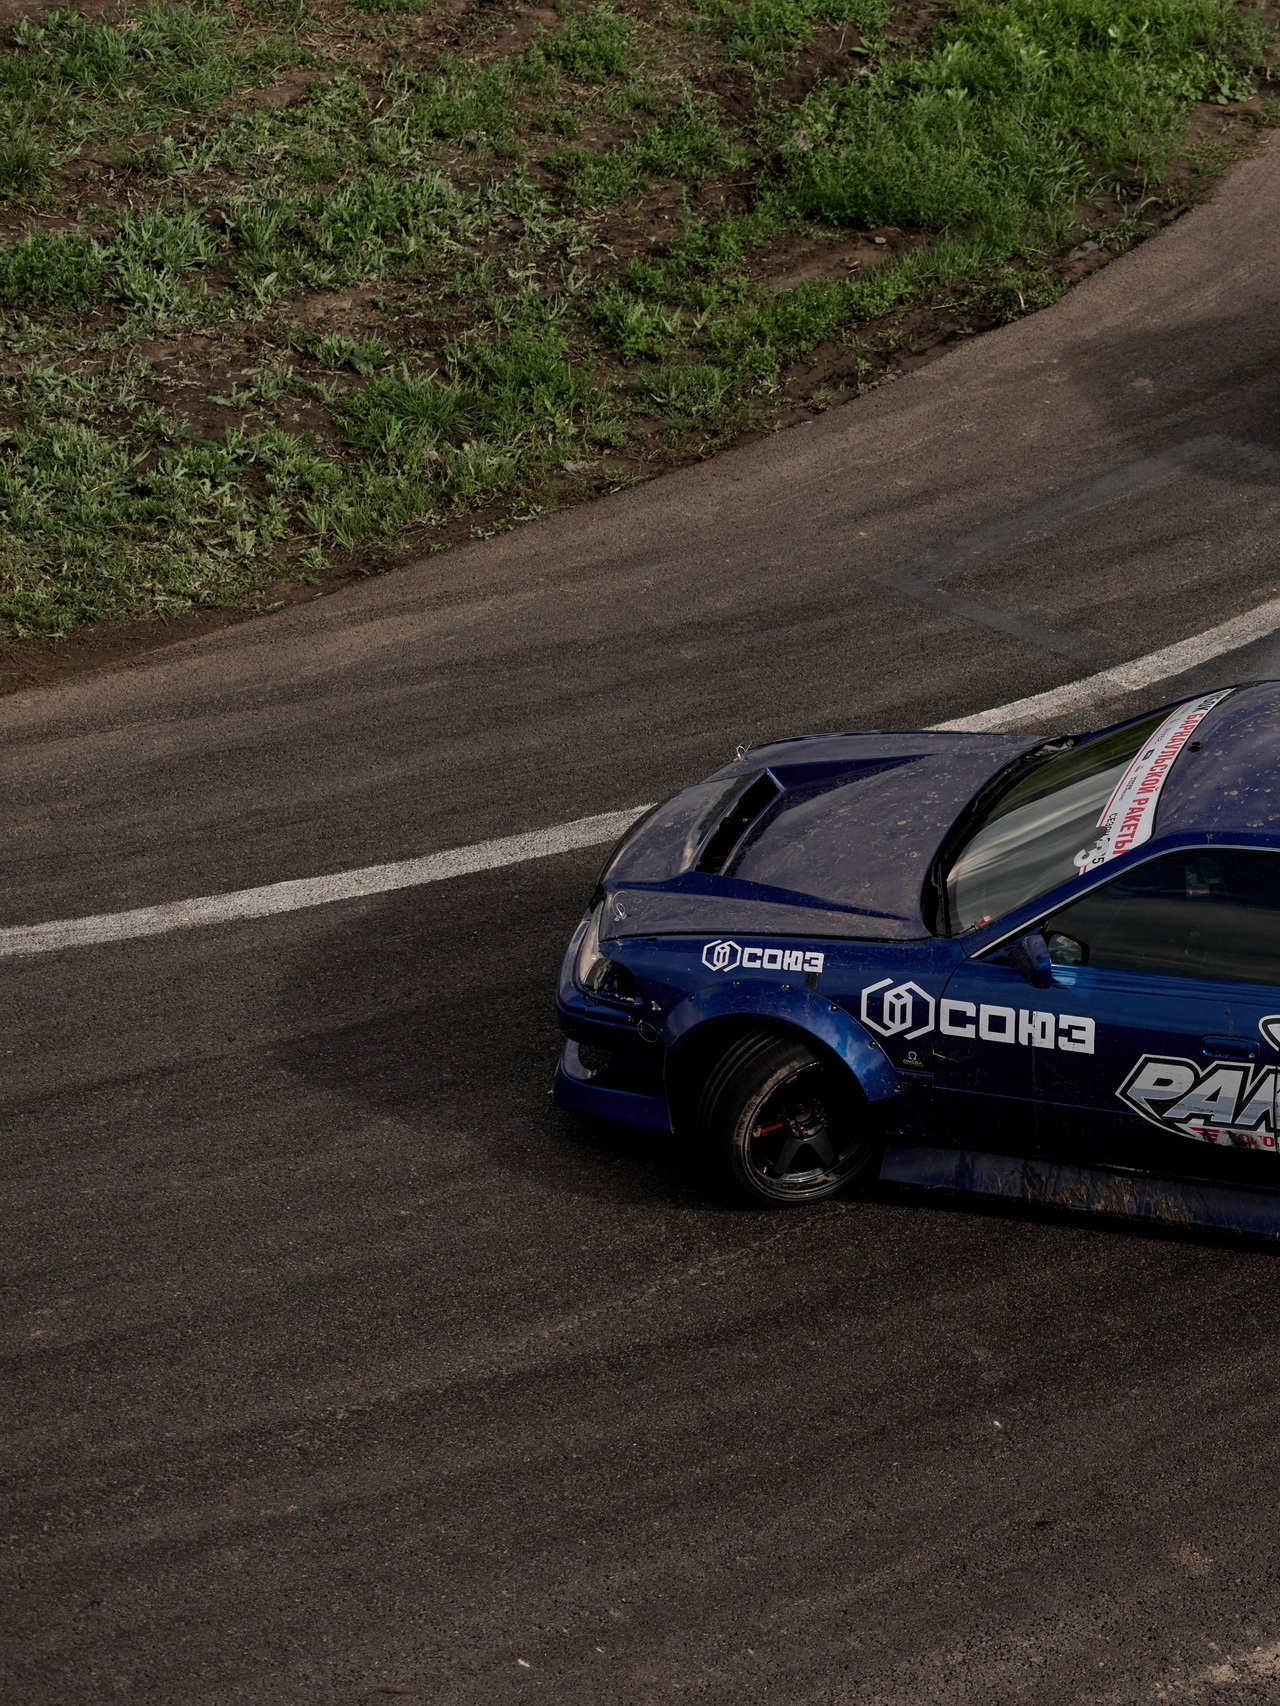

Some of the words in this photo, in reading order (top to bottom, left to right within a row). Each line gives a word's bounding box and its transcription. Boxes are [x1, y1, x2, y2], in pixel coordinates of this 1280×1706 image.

[1136, 712, 1205, 795] БАРНАУЛЬСКОЙ
[1111, 797, 1150, 855] РАКЕТЫ
[742, 946, 825, 974] СОЮЗ
[939, 997, 1095, 1055] СОЮЗ
